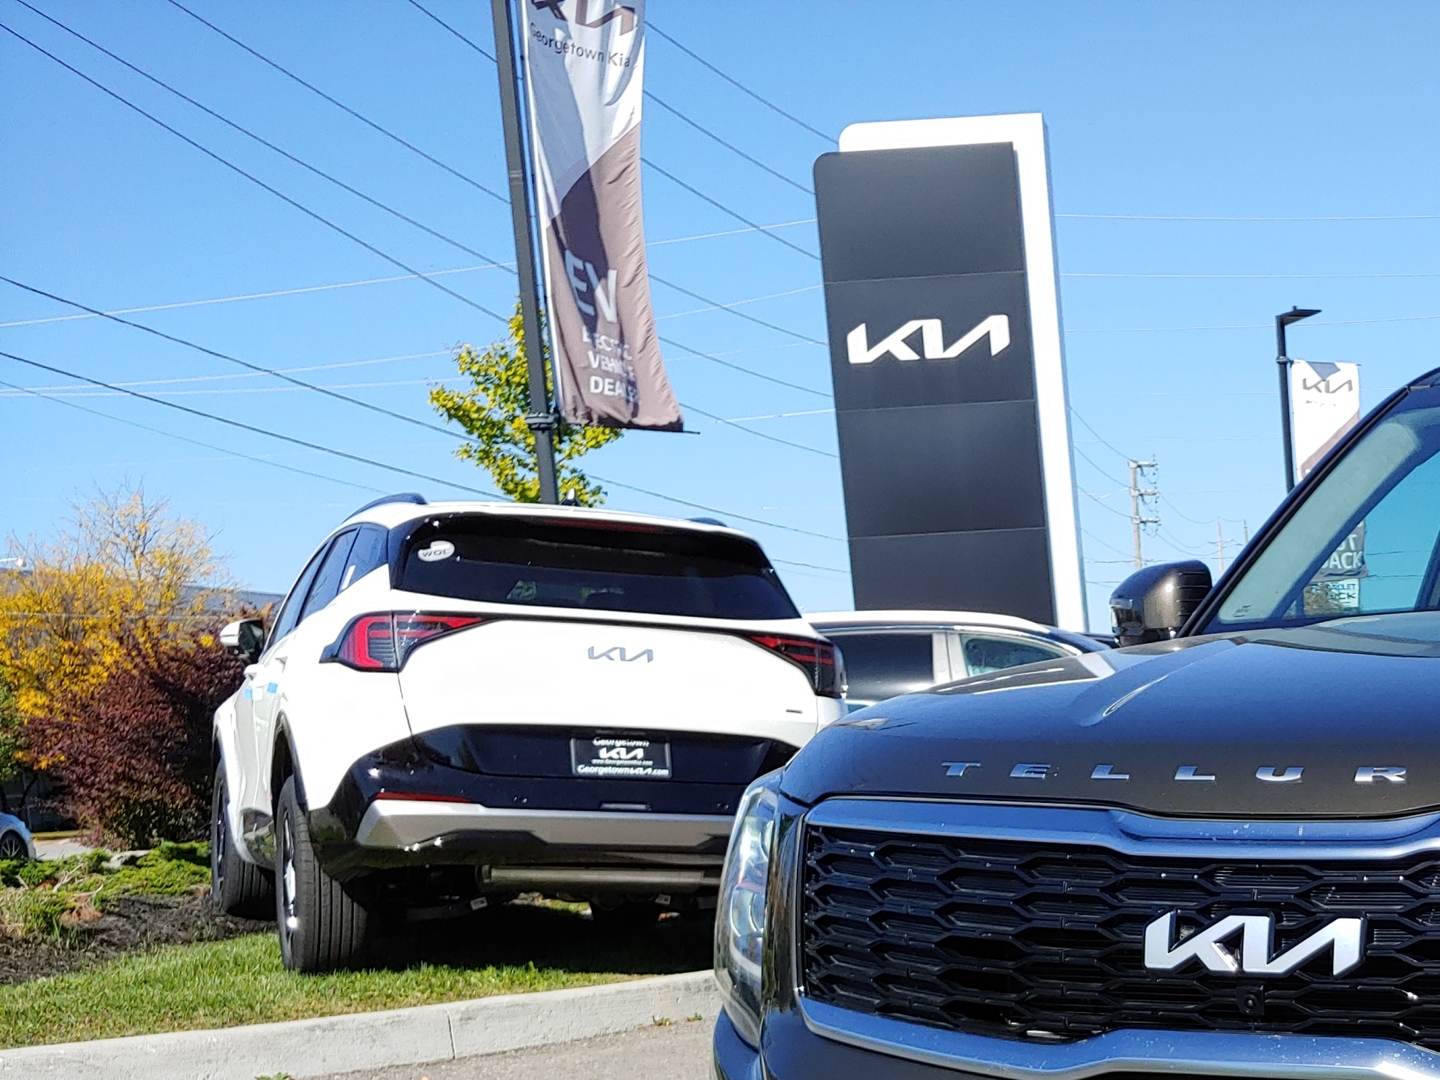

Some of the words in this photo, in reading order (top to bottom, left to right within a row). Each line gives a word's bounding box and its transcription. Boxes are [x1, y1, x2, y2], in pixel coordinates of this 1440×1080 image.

[530, 22, 605, 63] Georgetown
[608, 52, 630, 67] Kia
[565, 249, 618, 323] EV
[847, 314, 1010, 364] KIA
[1302, 378, 1353, 394] KIA
[587, 646, 653, 663] KIA
[599, 747, 644, 759] KIA
[1143, 909, 1365, 977] KIA
